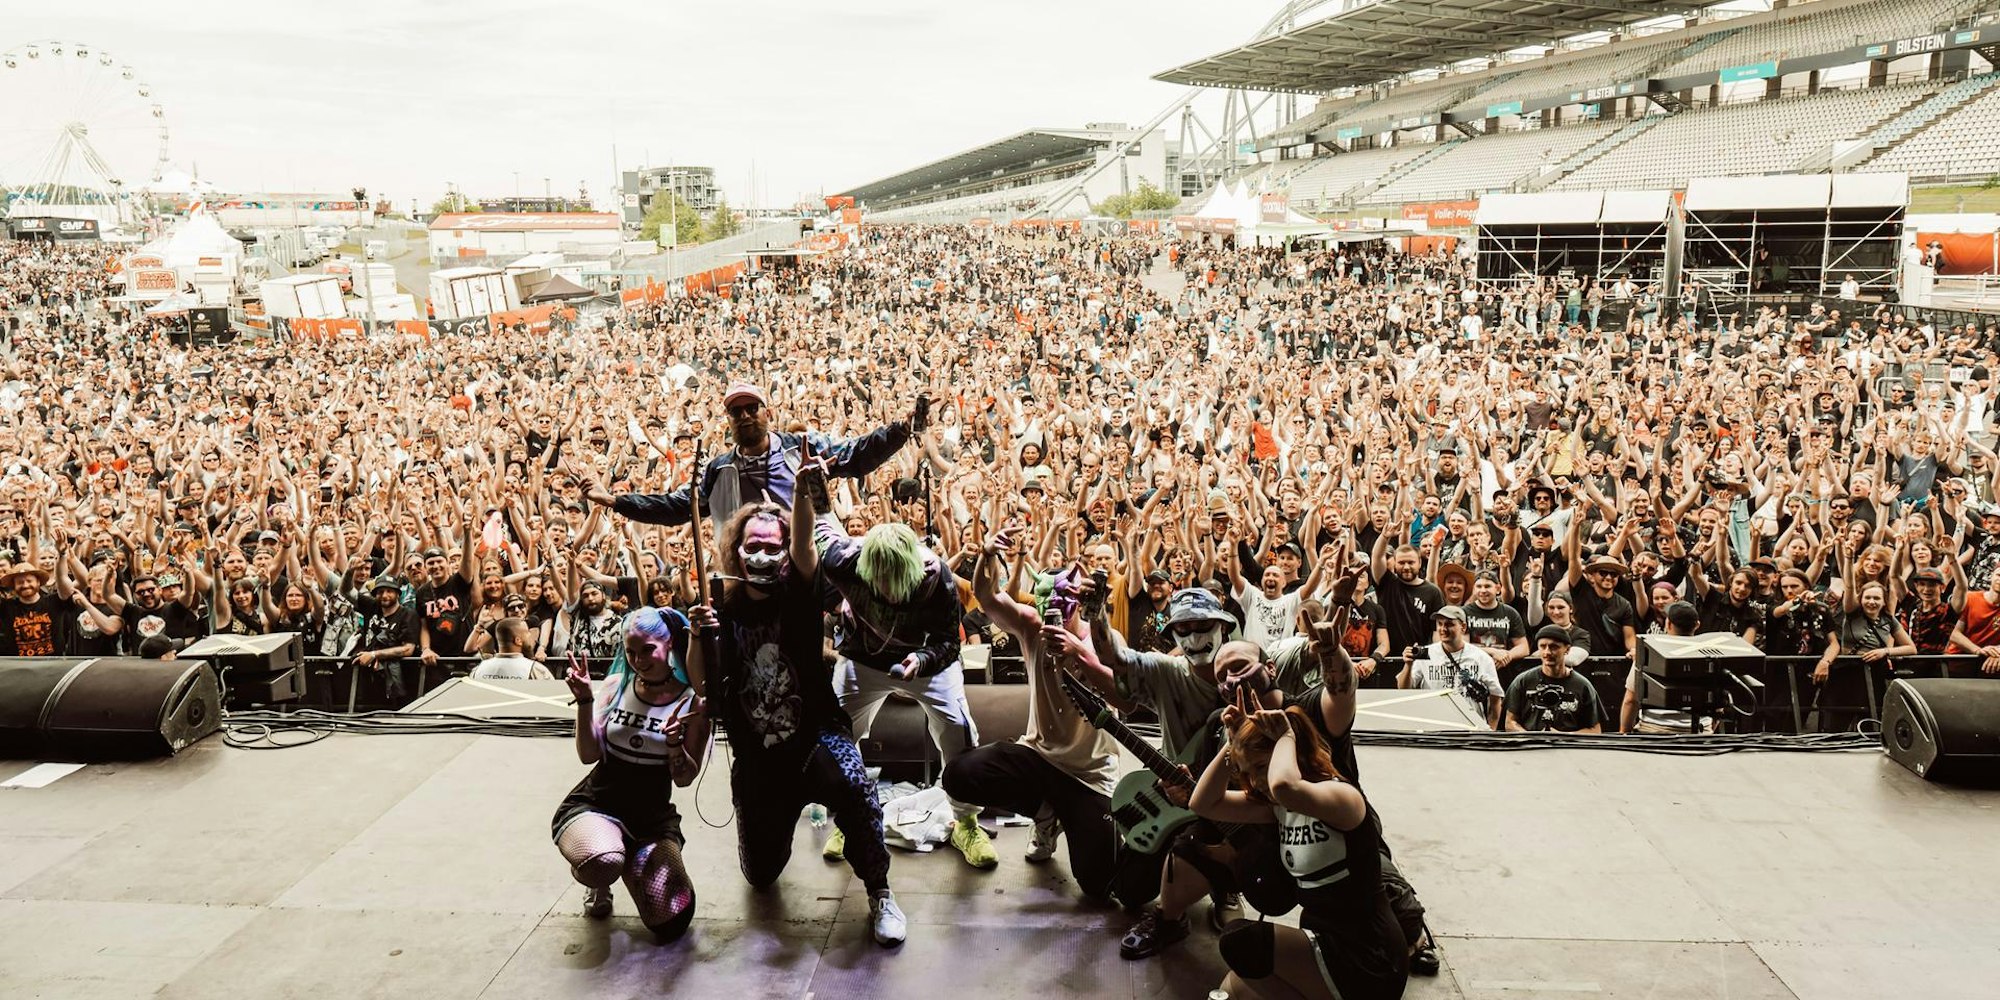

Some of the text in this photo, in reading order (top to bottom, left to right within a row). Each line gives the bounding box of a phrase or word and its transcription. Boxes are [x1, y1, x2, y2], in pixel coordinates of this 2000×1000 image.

[1896, 33, 1946, 55] BILSTEIN
[1587, 86, 1616, 101] BILSTEIN
[1413, 597, 1426, 613] TAA
